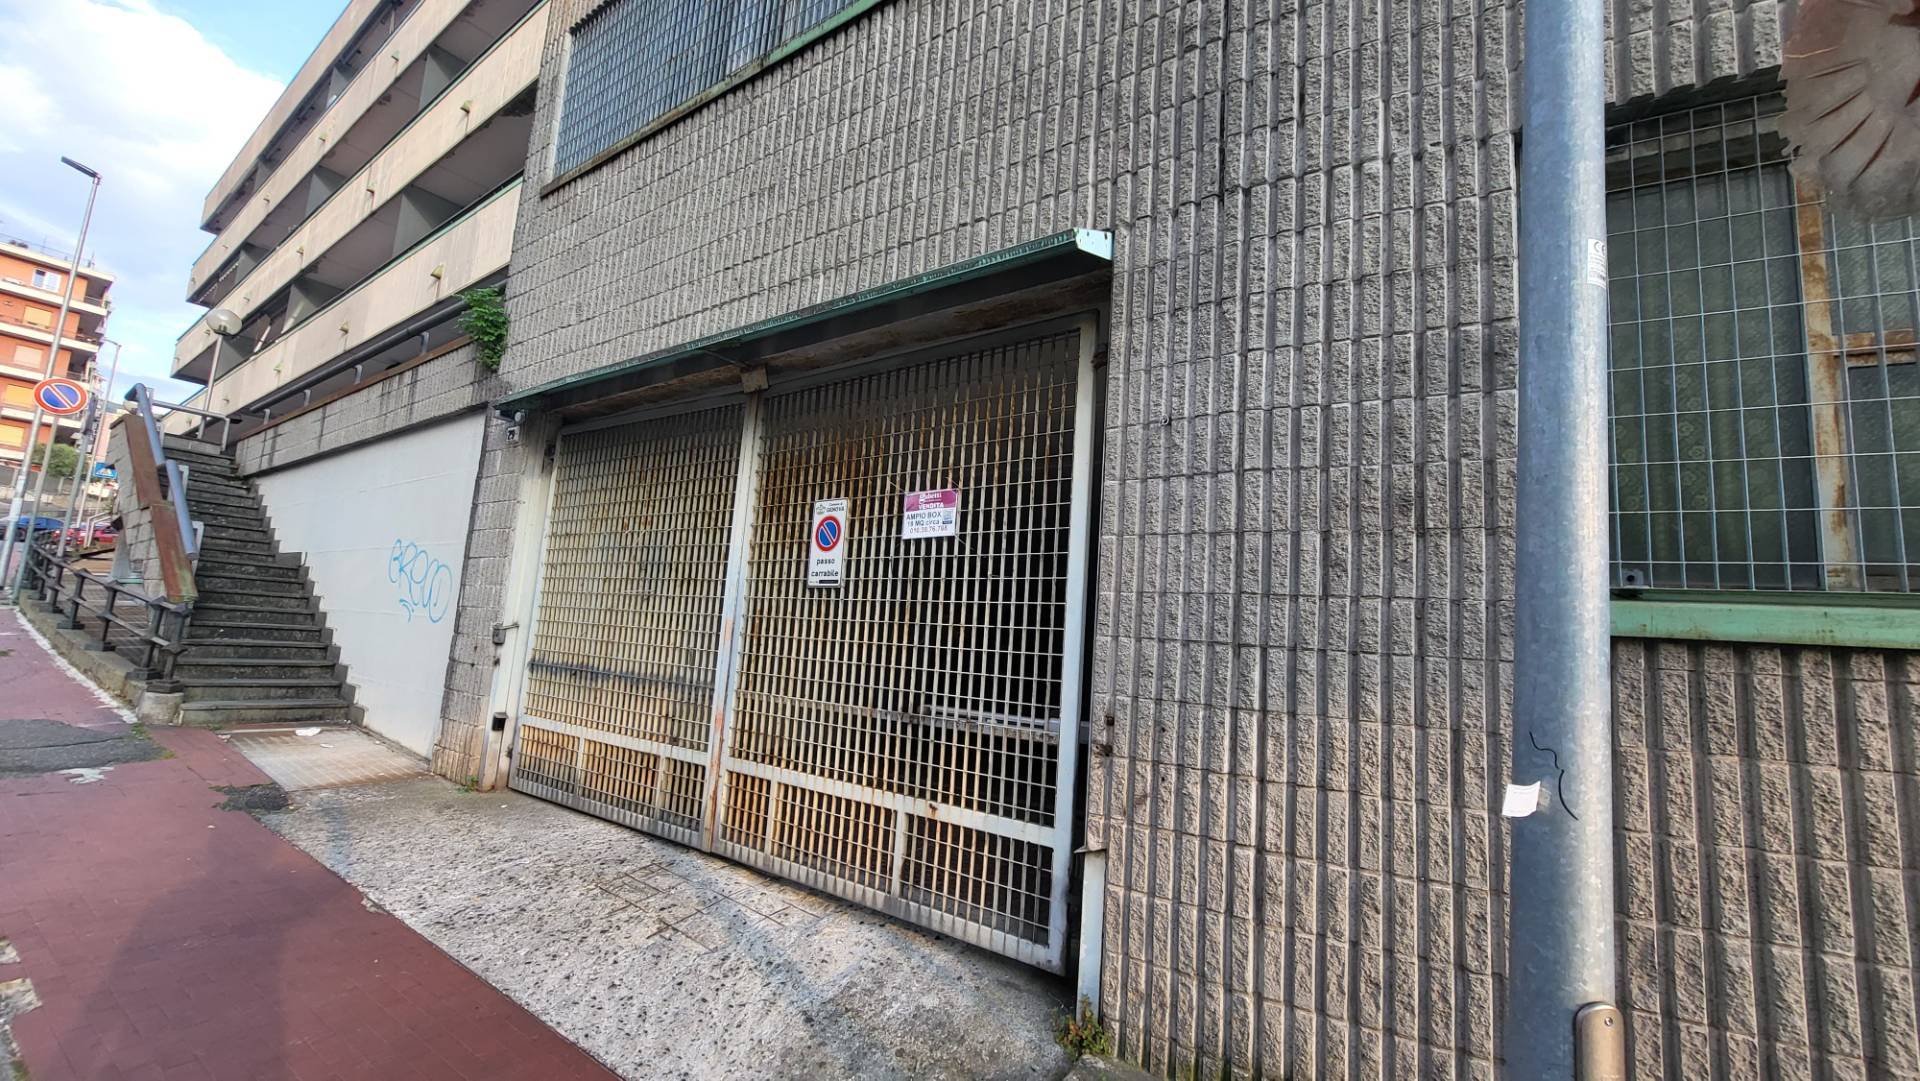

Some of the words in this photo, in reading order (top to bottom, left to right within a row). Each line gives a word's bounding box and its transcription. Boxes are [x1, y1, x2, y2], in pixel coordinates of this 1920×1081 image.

[919, 502, 944, 510] VENDITA
[906, 512, 926, 520] AMPIO
[927, 511, 942, 519] BOX
[816, 558, 835, 566] passo
[810, 569, 839, 577] carrabile
